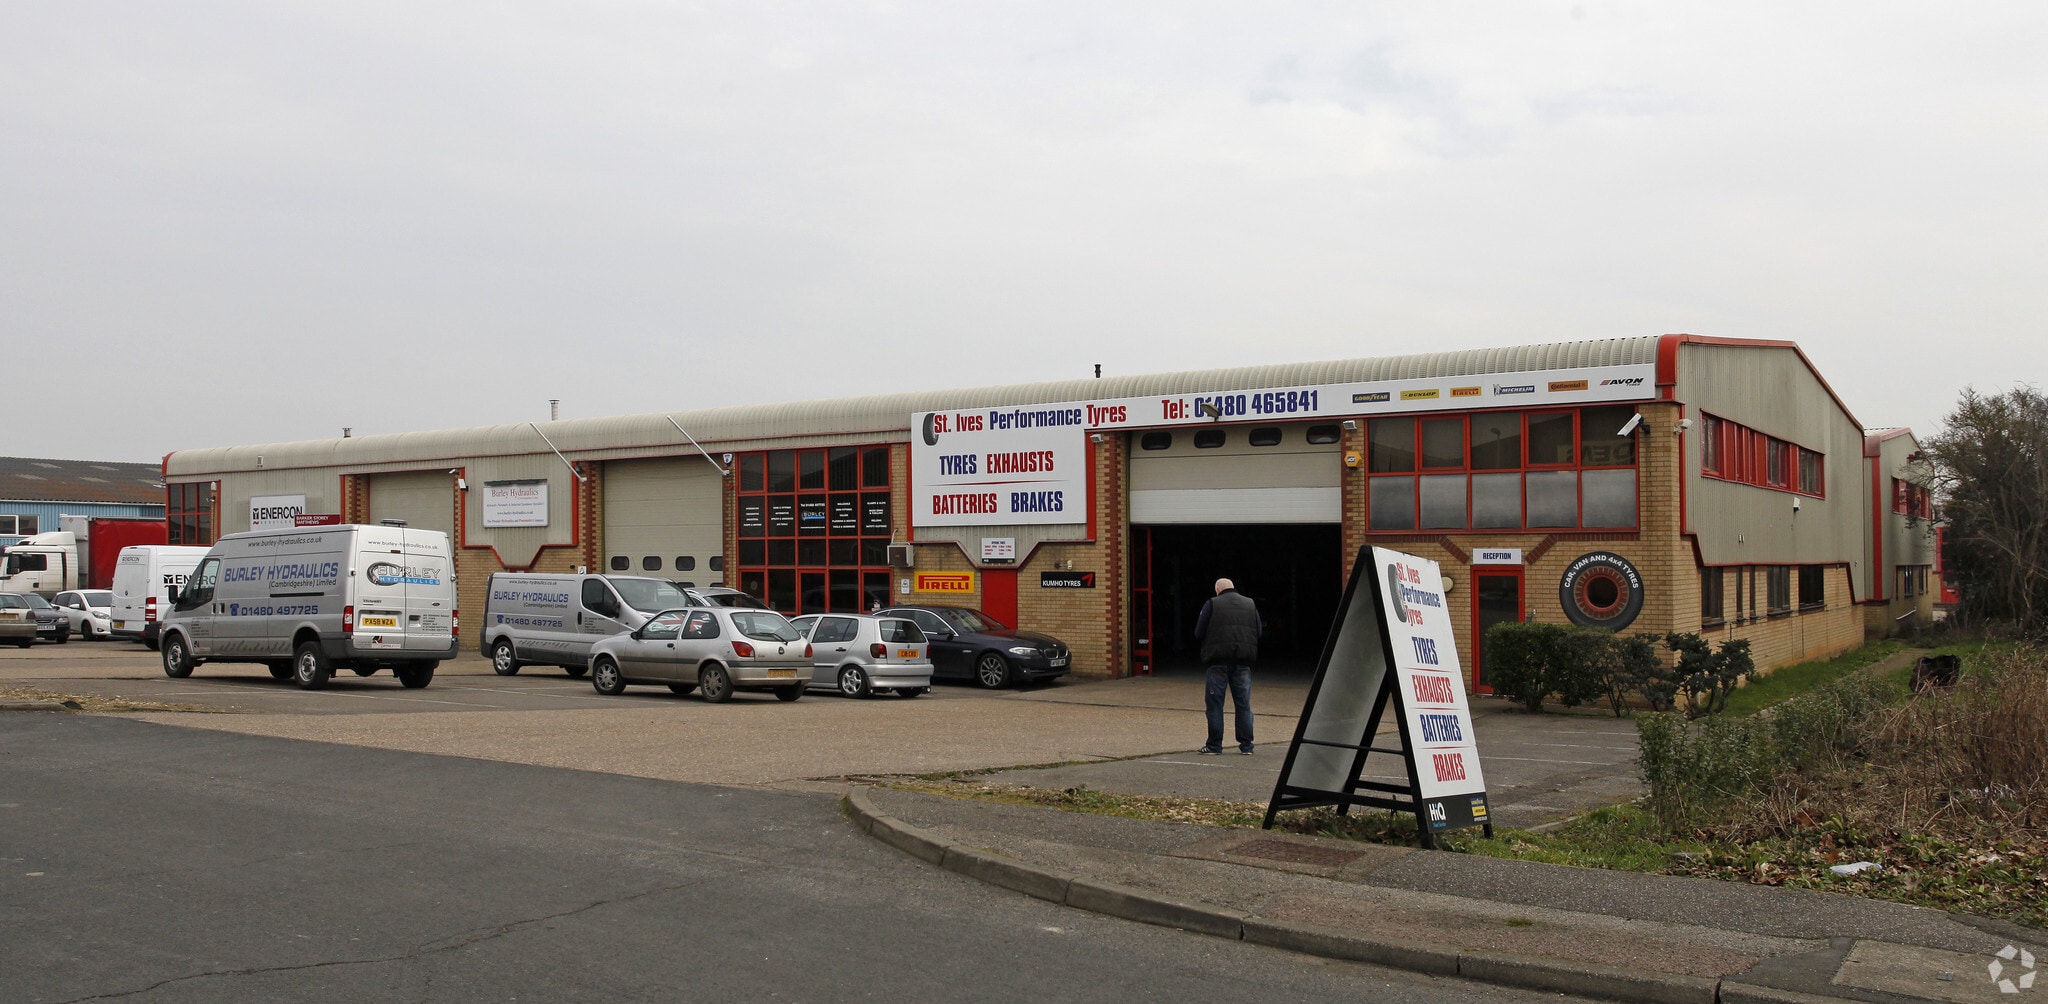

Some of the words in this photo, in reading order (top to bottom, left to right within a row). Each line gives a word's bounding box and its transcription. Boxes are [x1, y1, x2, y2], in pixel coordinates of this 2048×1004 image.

[1452, 388, 1479, 396] PIRELLI
[1162, 399, 1189, 420] Tel:
[1252, 390, 1318, 414] 465841
[934, 416, 952, 434] St.
[956, 414, 983, 432] Ives
[989, 408, 1082, 430] Performance
[1086, 404, 1127, 427] Tyres
[939, 454, 977, 476] TYRES
[986, 451, 1054, 474] EXHAUSTS
[491, 490, 509, 498] Burley
[510, 488, 539, 498] Hydraulics
[932, 493, 998, 515] BATTERIES
[1011, 491, 1063, 513] BRAKES
[260, 506, 302, 520] ENERCON
[248, 536, 322, 547] www.burley-hydraulics.co.uk
[224, 565, 265, 582] BURLEY
[267, 562, 339, 580] HYDRAULICS
[378, 565, 440, 578] BURLEY
[380, 576, 440, 585] HYDRAULICS
[1396, 562, 1408, 582] St.
[1406, 564, 1421, 584] Ives
[1564, 572, 1576, 588] CAR,
[1573, 558, 1589, 570] VAN
[1608, 556, 1622, 566] 4x4
[1622, 564, 1639, 588] TYRES
[268, 580, 316, 589] (Cambridgeshire)
[918, 575, 970, 590] PIRELLI
[494, 591, 520, 600] BURLEY
[522, 592, 569, 603] HYDRAULICS
[1401, 584, 1441, 608] Performance
[242, 607, 274, 616] 01480
[277, 605, 318, 615] 497725
[1404, 605, 1423, 627] Tyres
[532, 619, 563, 628] 497725
[1412, 636, 1439, 665] TYRES
[1412, 675, 1454, 703] EXHAUSTS
[1420, 714, 1462, 742] BATTERIES
[1433, 753, 1466, 782] BRAKES
[1429, 802, 1446, 821] HiQ
